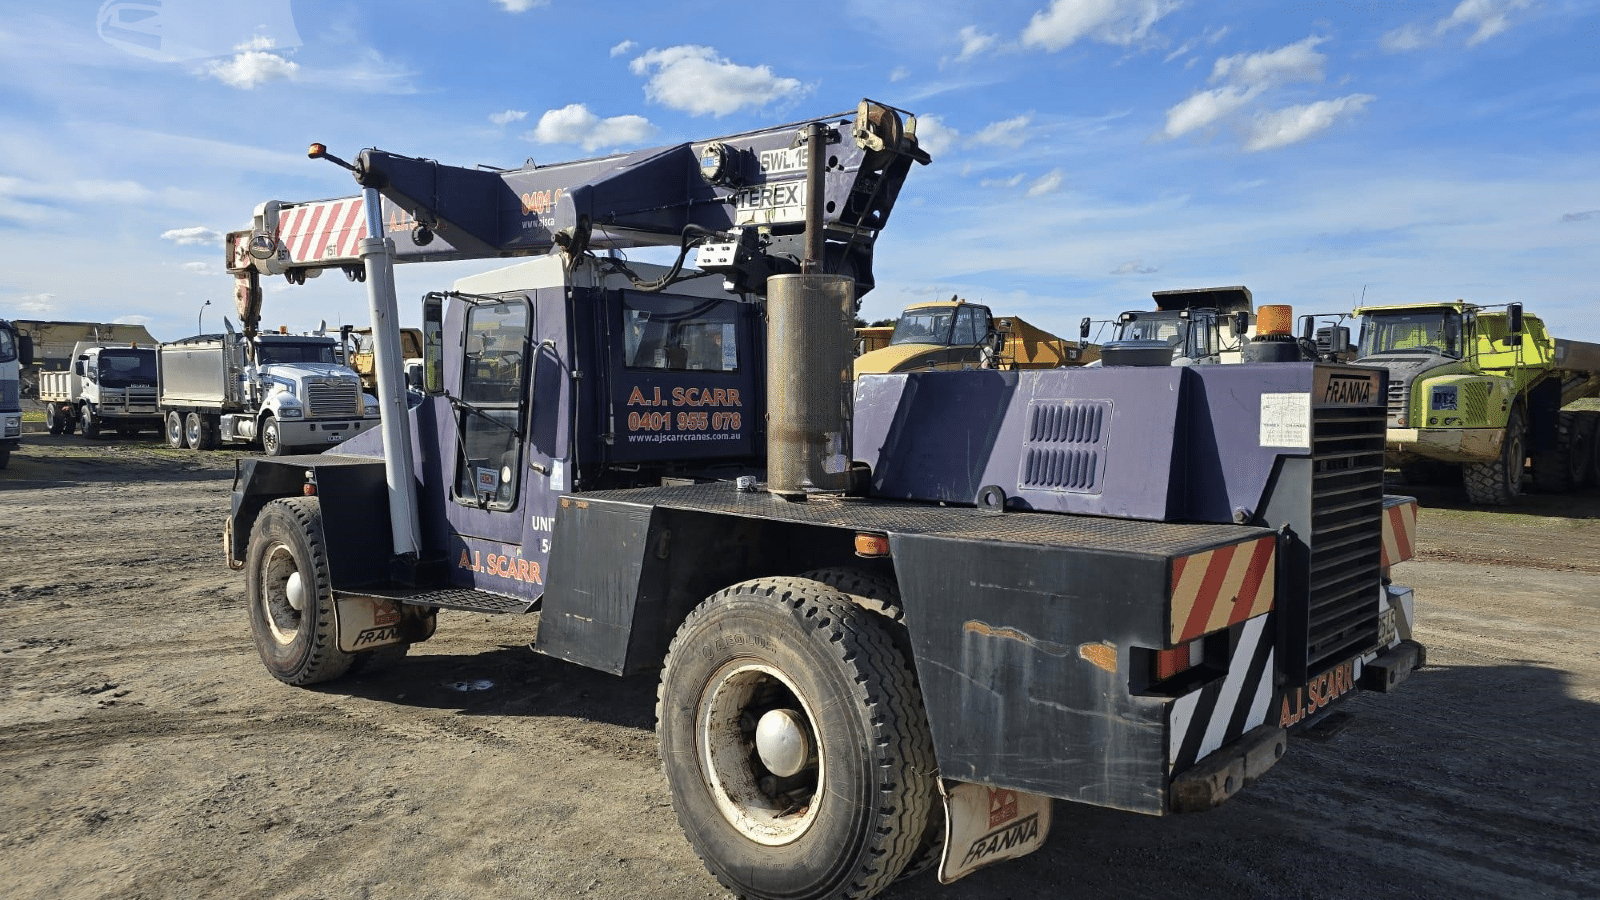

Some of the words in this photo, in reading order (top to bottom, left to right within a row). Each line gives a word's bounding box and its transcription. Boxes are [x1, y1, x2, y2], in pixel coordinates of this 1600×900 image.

[738, 184, 798, 208] TEREX
[627, 386, 668, 407] A.J.
[671, 386, 743, 407] SCARR
[1324, 373, 1372, 404] FRANNA
[627, 411, 672, 432] 0401
[676, 411, 709, 431] 955
[711, 411, 742, 431] 078
[628, 432, 741, 444] www.ajscarrcranes.com.au
[541, 538, 552, 553] 5
[458, 548, 485, 574] A.J.
[486, 553, 543, 586] SCARR
[1278, 687, 1306, 729] A.J.
[1307, 664, 1354, 715] SCARR
[959, 811, 1039, 868] FRANNA
